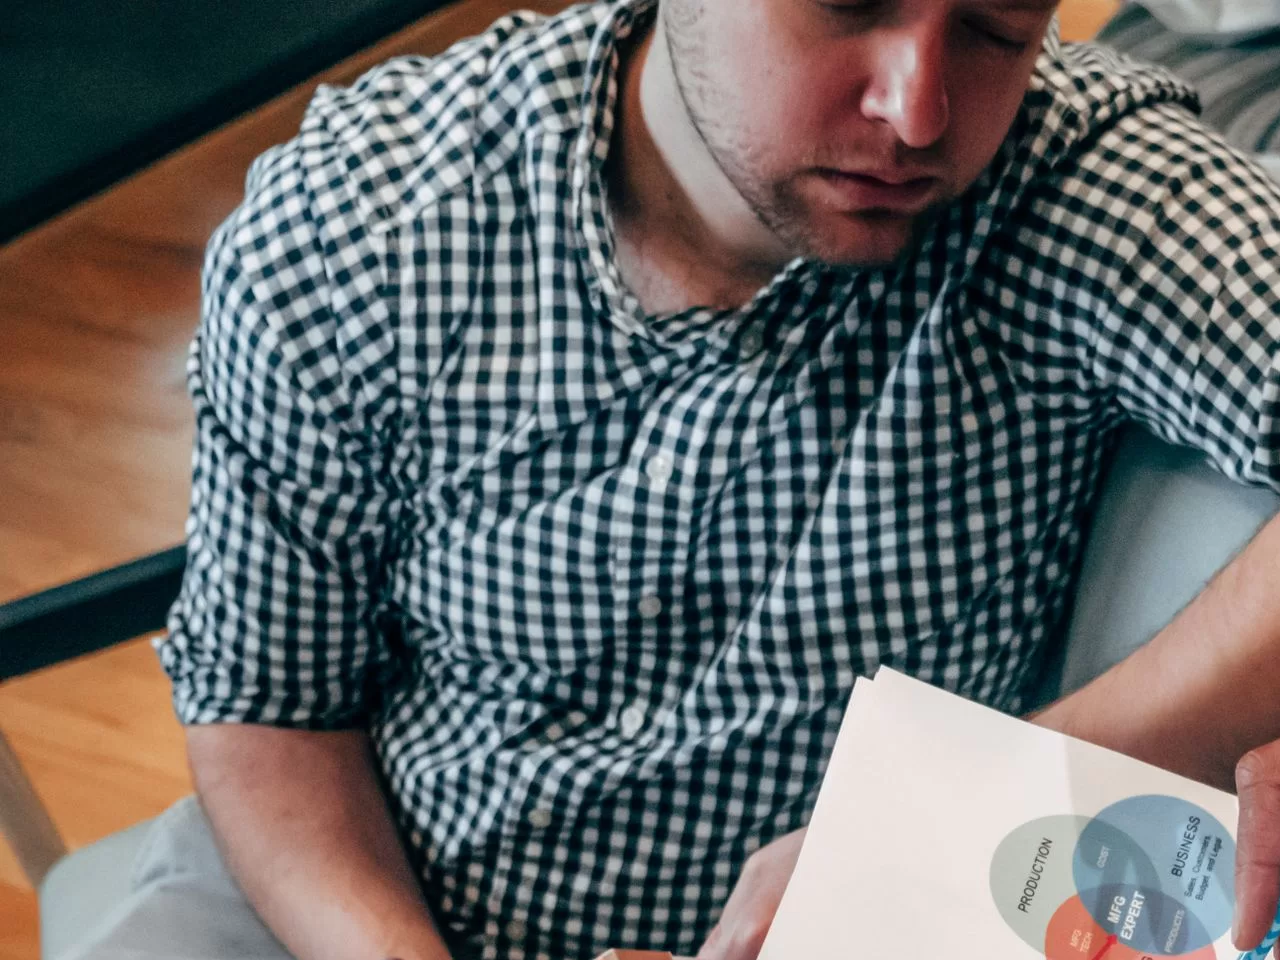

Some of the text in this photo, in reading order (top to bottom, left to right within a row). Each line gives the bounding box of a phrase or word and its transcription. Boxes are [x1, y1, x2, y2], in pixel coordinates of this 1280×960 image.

[1096, 845, 1110, 869] COST
[1171, 815, 1201, 878] BUSINESS
[1017, 837, 1053, 913] PRODUCTION
[1106, 895, 1126, 924] MFG
[1119, 891, 1146, 941] EXPERT
[1164, 909, 1186, 954] PRODUCTS
[1080, 931, 1094, 953] TECH
